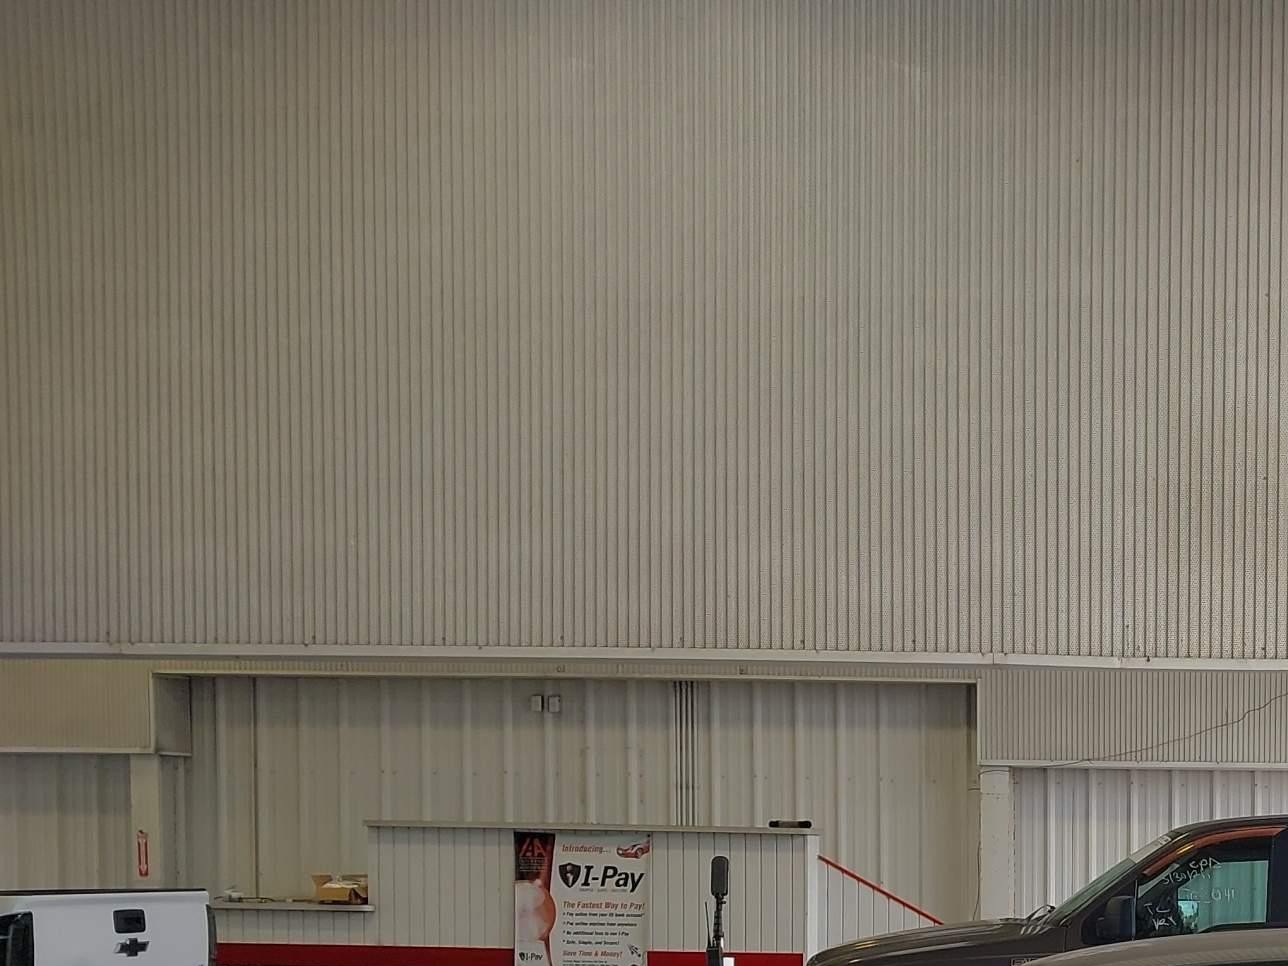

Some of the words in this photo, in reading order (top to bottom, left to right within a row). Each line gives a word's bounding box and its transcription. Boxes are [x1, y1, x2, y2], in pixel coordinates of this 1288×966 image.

[581, 865, 645, 893] I-Pay
[563, 901, 575, 909] The
[577, 901, 603, 909] Fastest
[605, 902, 619, 910] Way
[630, 902, 645, 910] Pay!
